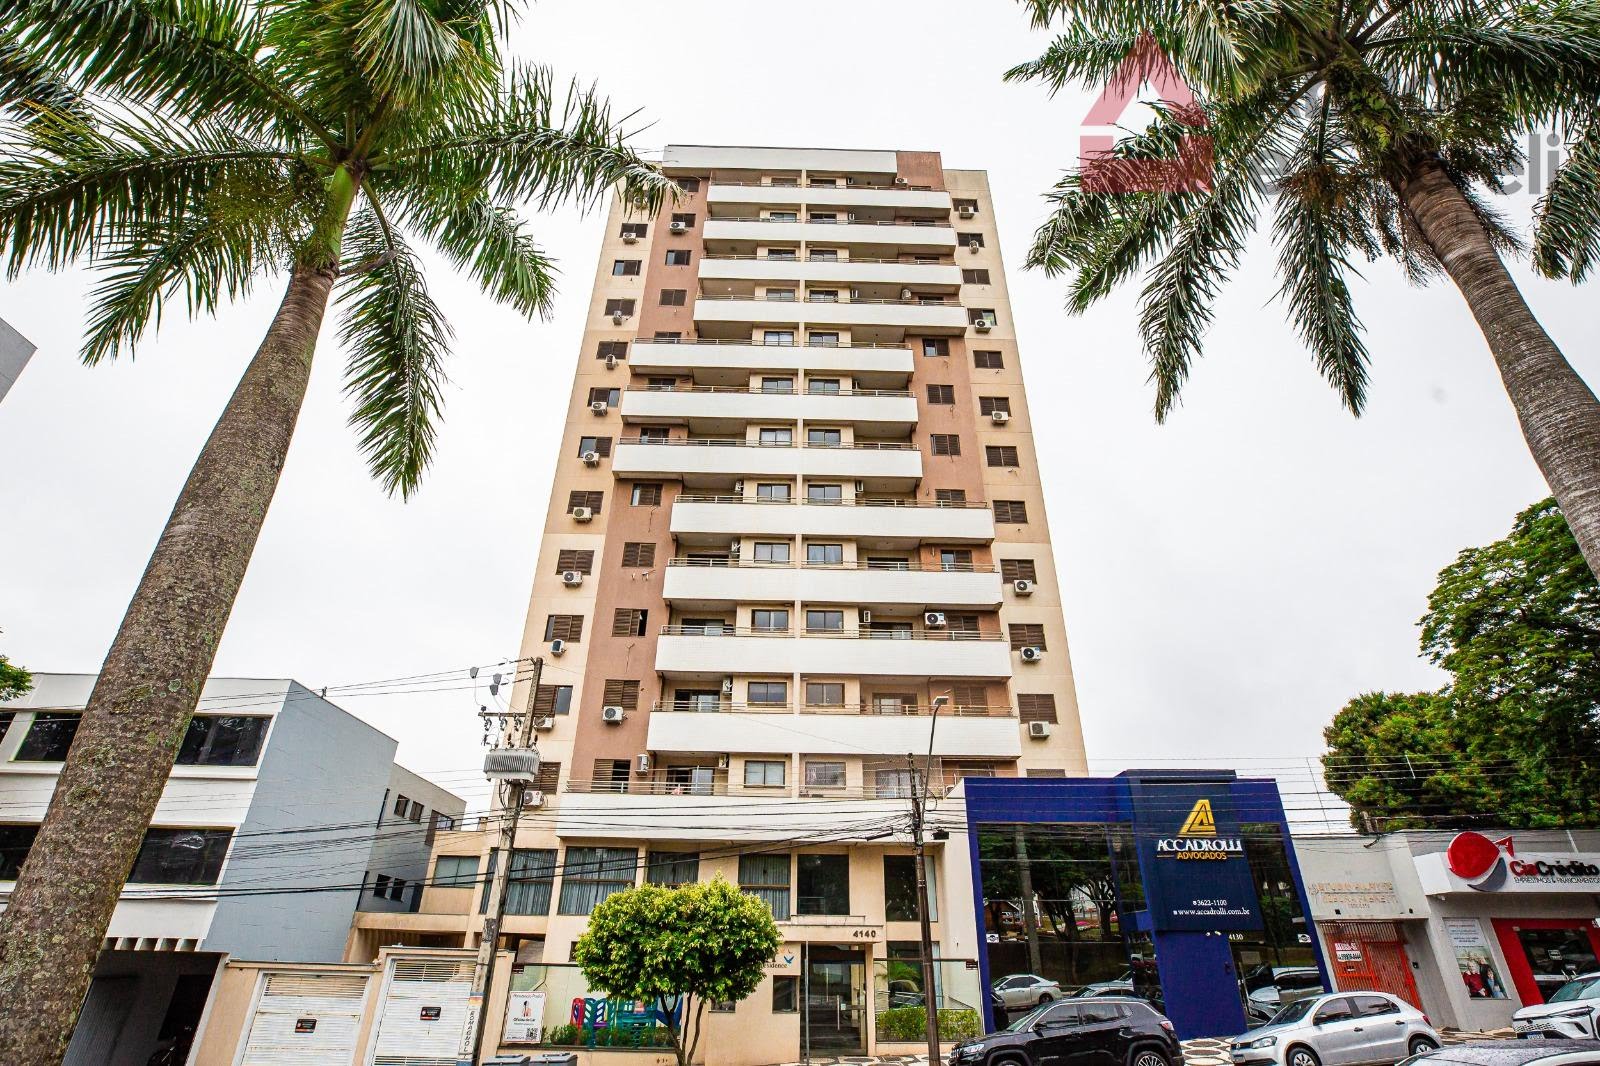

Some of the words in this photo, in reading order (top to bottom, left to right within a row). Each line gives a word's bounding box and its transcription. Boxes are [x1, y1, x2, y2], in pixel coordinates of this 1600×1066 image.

[1157, 839, 1243, 851] ACCADROLLI
[1176, 851, 1228, 860] ADVOGADOS
[1178, 907, 1250, 915] www.accadrolli.com.br
[853, 930, 877, 938] 4140
